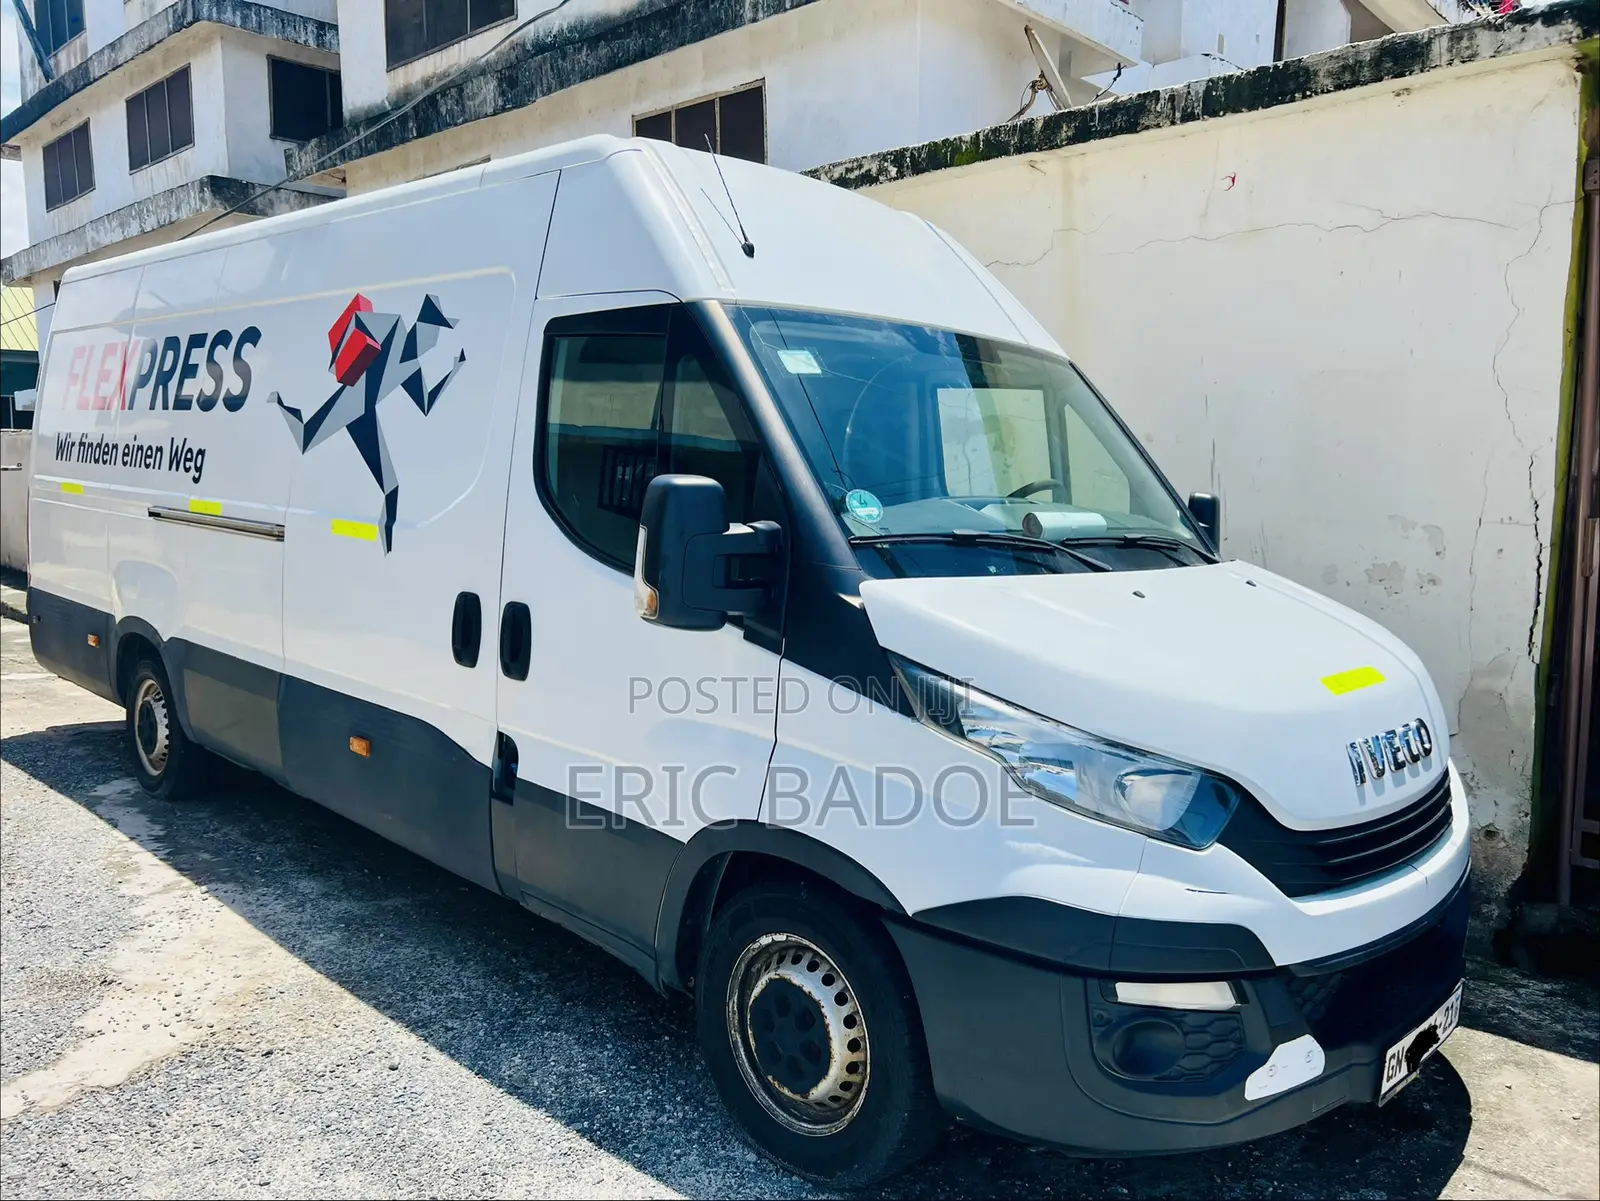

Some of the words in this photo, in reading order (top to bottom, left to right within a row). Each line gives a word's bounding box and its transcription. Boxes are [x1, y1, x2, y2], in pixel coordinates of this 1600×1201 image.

[61, 326, 262, 412] FLEXPRESS
[55, 432, 76, 462] Wir
[76, 432, 119, 466] finden
[121, 434, 164, 470] einen
[167, 437, 207, 484] Weg
[1346, 717, 1432, 787] IVECO
